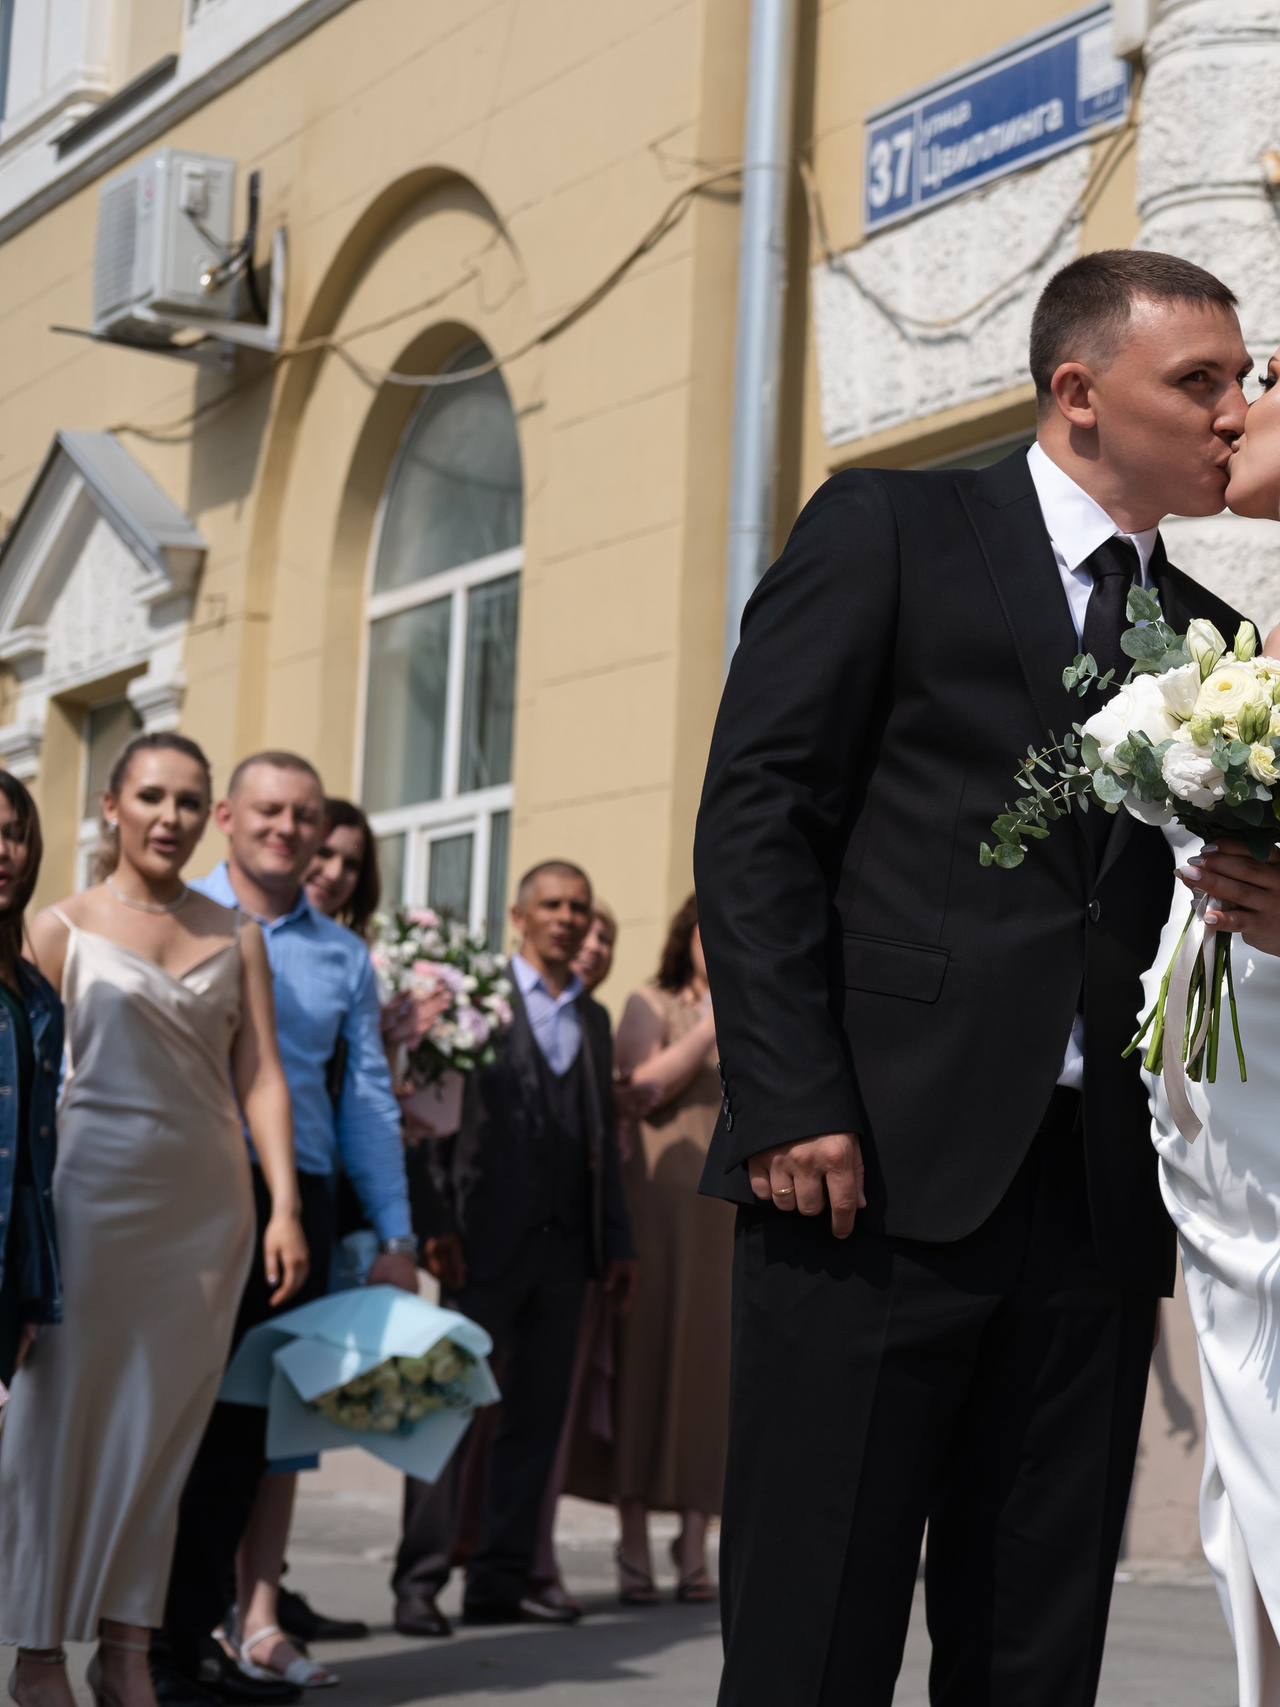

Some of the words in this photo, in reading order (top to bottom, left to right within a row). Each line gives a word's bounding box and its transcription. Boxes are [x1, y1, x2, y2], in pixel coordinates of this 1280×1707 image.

[920, 100, 971, 146] улица
[920, 97, 1064, 189] Цвиллинга
[869, 129, 914, 208] 37
